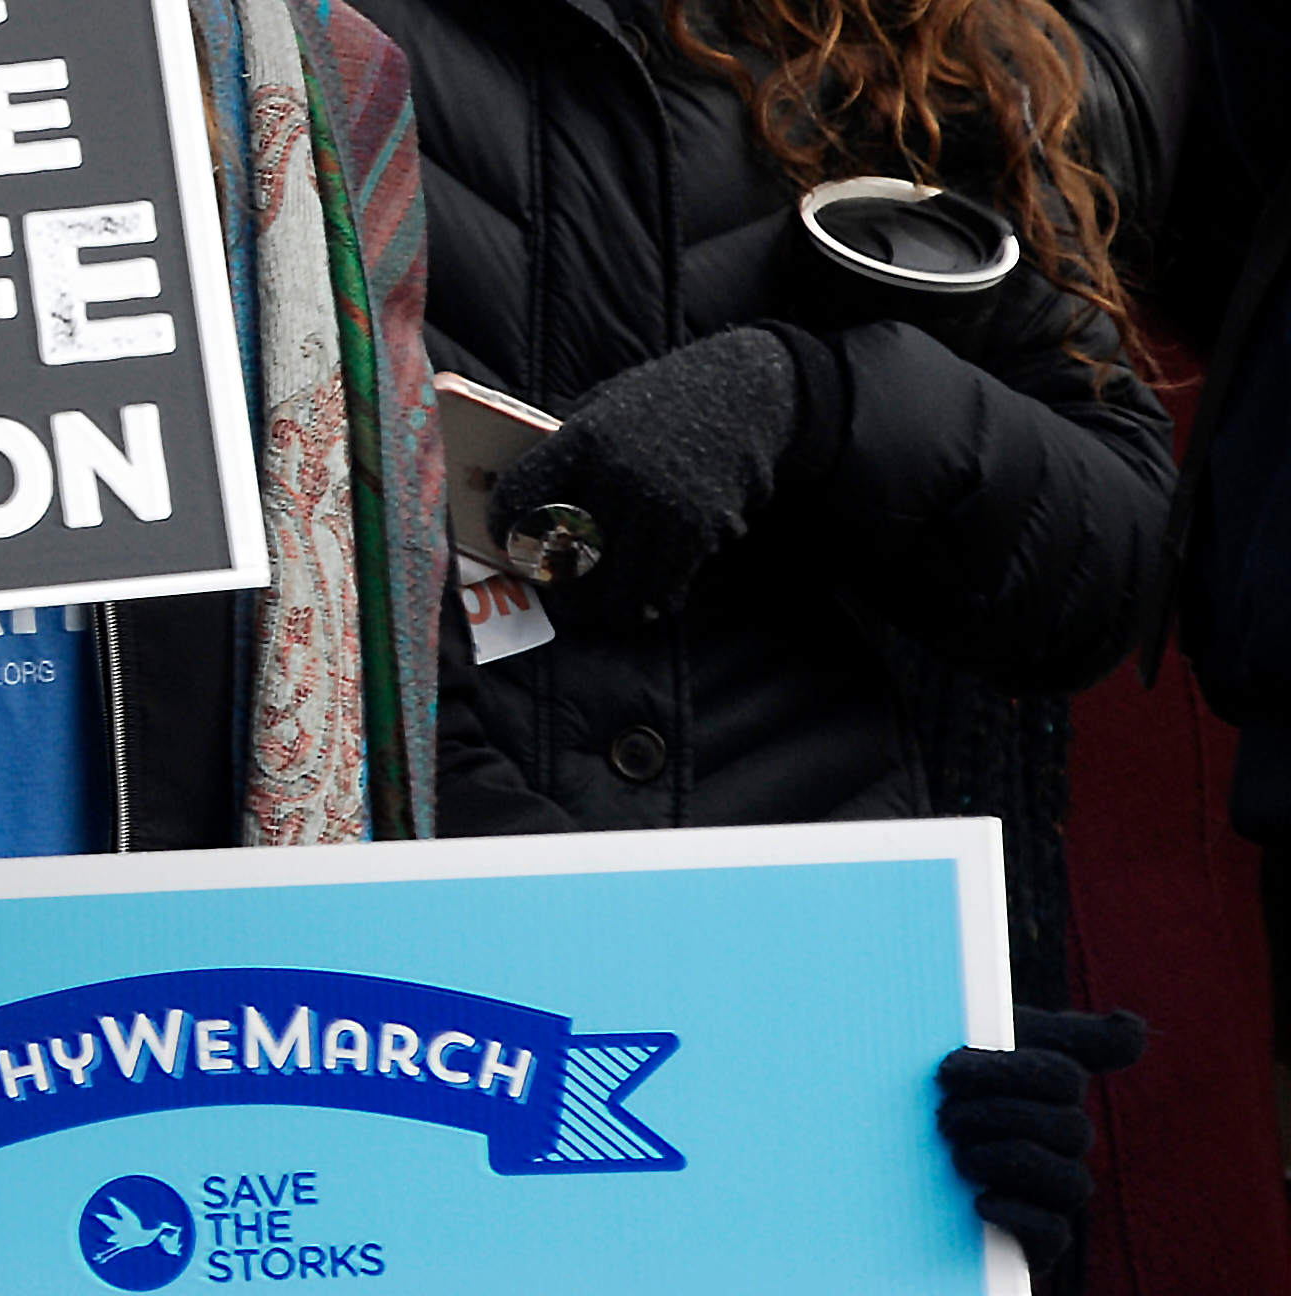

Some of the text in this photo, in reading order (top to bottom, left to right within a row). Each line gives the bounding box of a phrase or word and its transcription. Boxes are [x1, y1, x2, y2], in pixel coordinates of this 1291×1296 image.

[203, 1171, 319, 1210] SAVE
[204, 1209, 294, 1246] THE
[208, 1242, 386, 1283] STORKS
